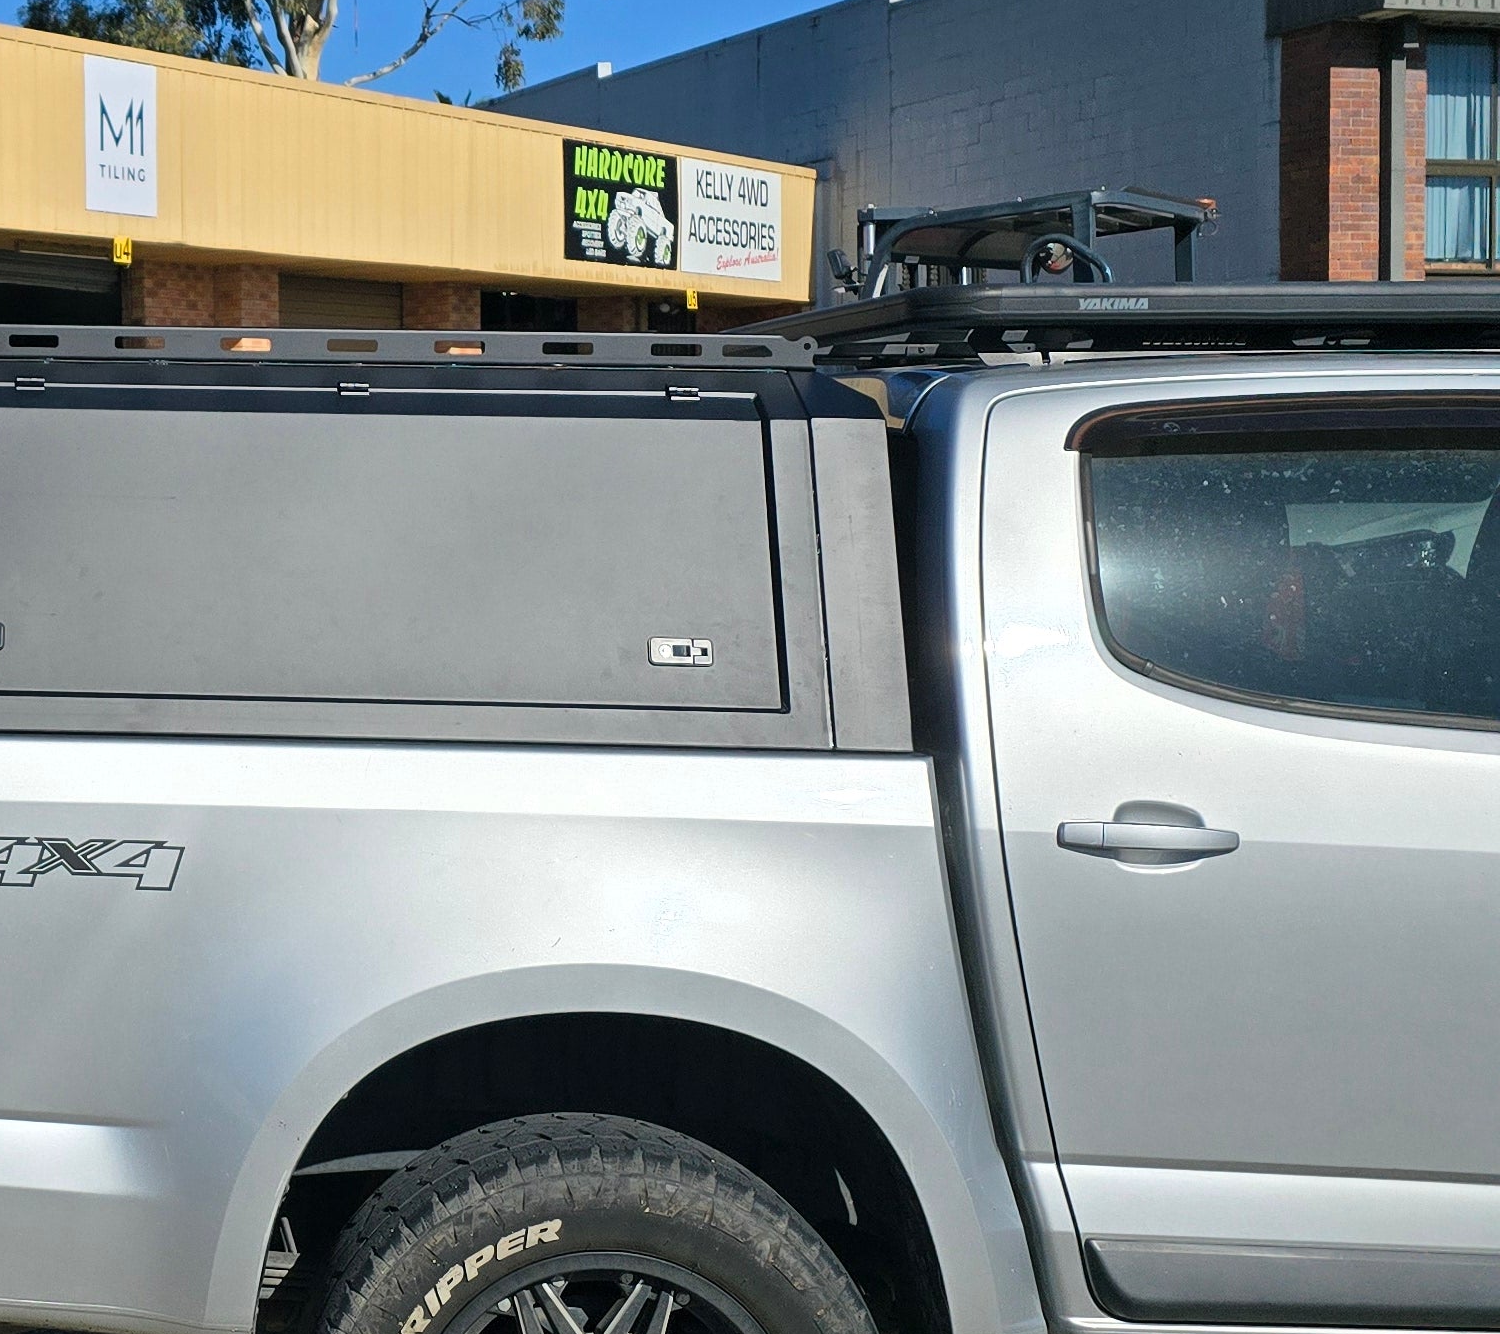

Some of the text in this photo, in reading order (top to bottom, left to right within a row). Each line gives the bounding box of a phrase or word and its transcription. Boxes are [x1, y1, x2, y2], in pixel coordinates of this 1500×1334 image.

[98, 163, 146, 183] TILING
[574, 145, 666, 188] HARDCORE
[574, 186, 609, 221] 4X4
[696, 168, 769, 207] KELLY 4WD
[688, 212, 776, 252] ACCESSORIES
[1078, 297, 1150, 311] YAKIMA
